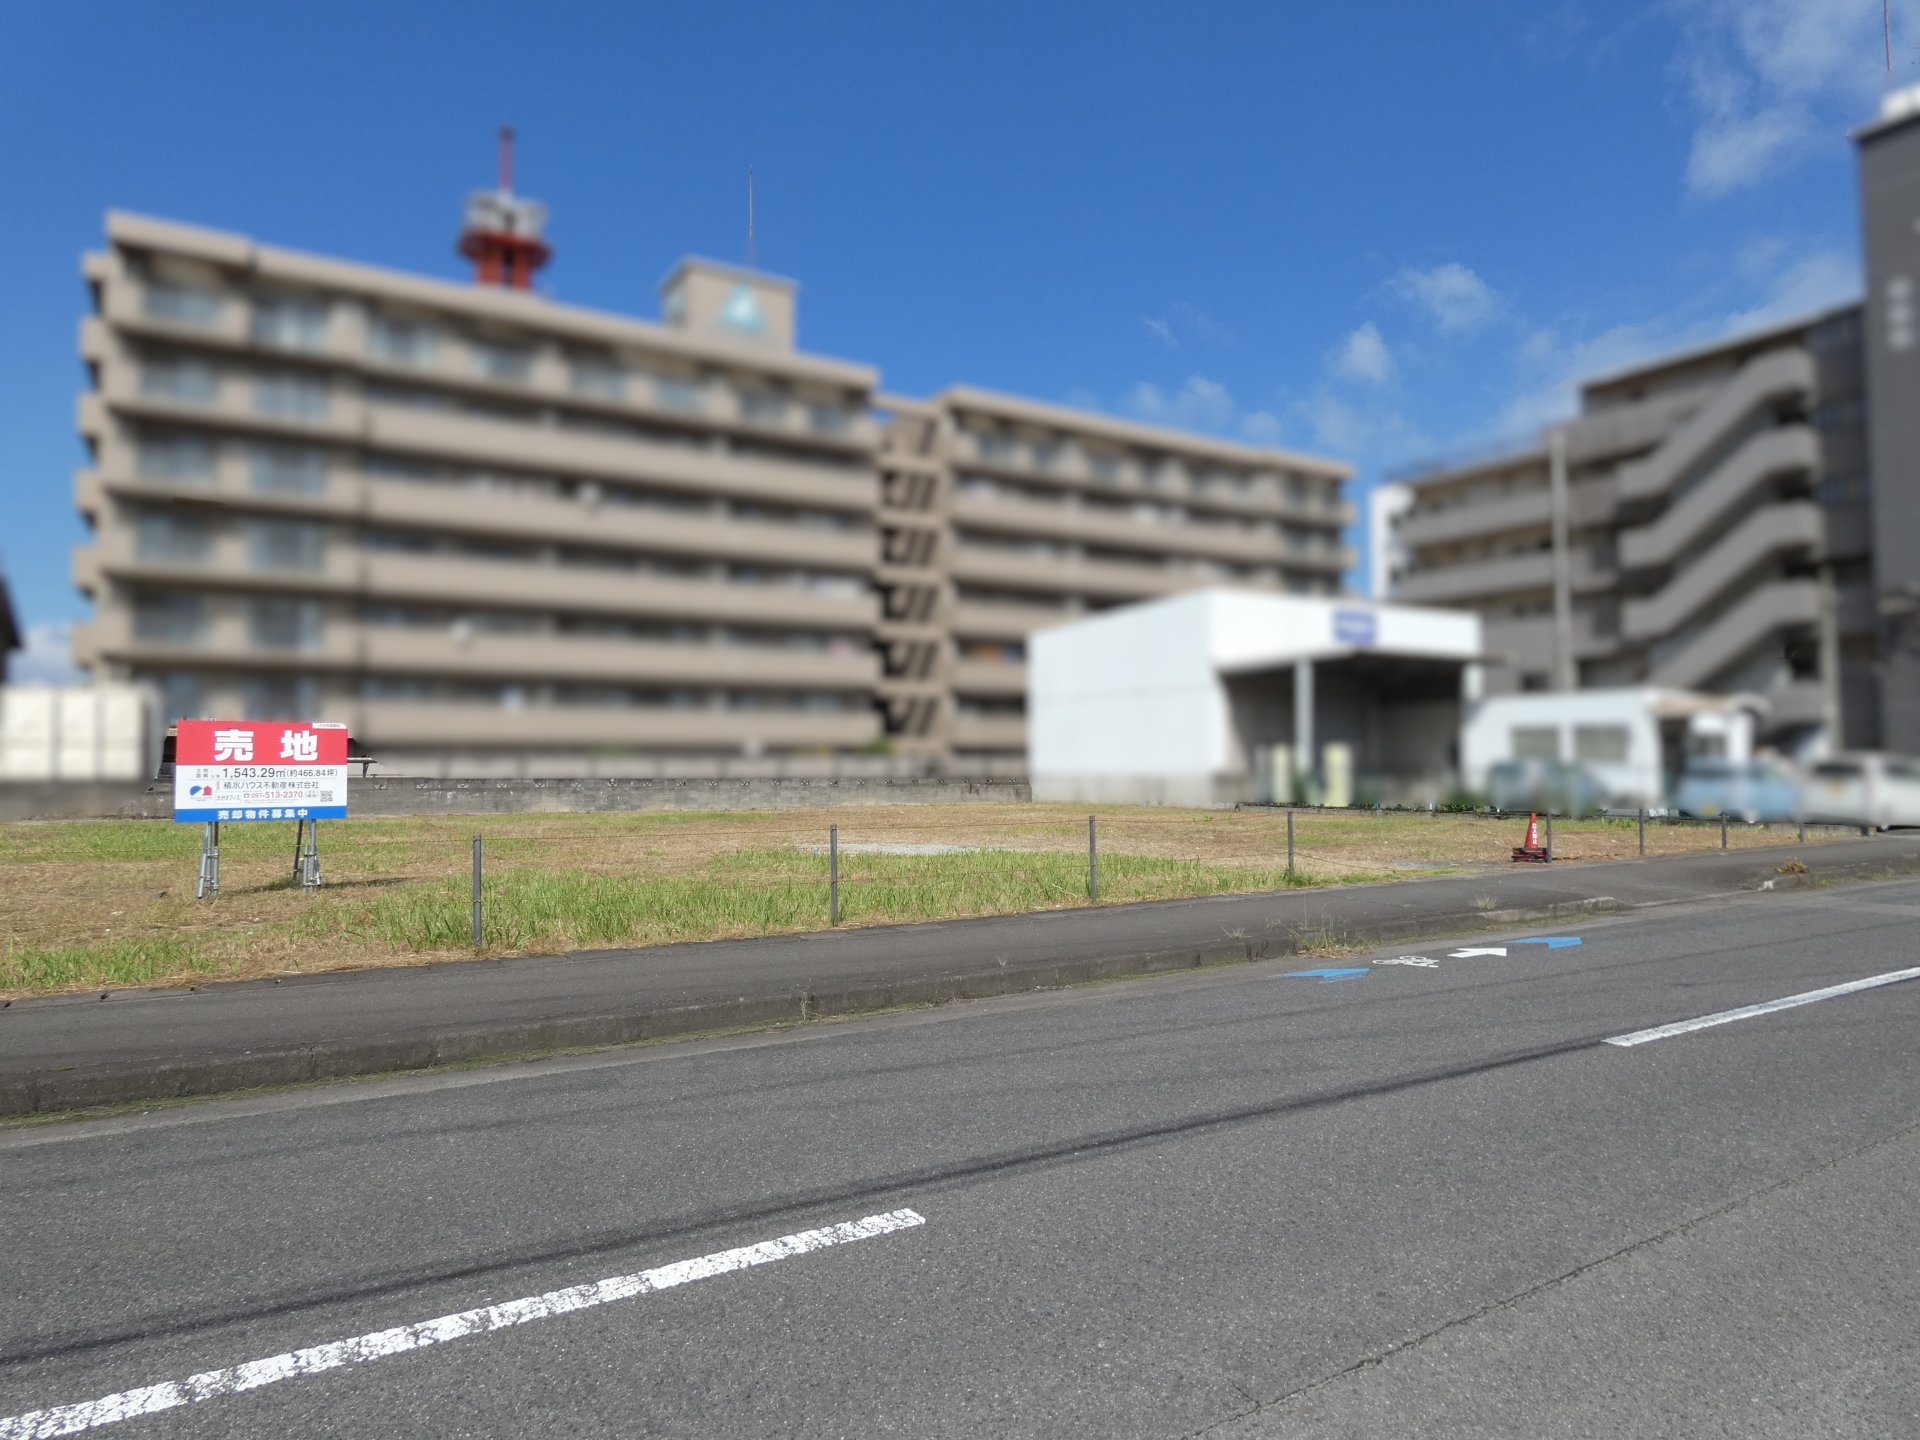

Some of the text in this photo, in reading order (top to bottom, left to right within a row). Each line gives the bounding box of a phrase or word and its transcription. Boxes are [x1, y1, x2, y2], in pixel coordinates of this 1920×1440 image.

[214, 729, 318, 761] 売地
[223, 781, 320, 790] 積水ハウス不動産株式会社
[217, 808, 308, 820] 売却物件募集中
